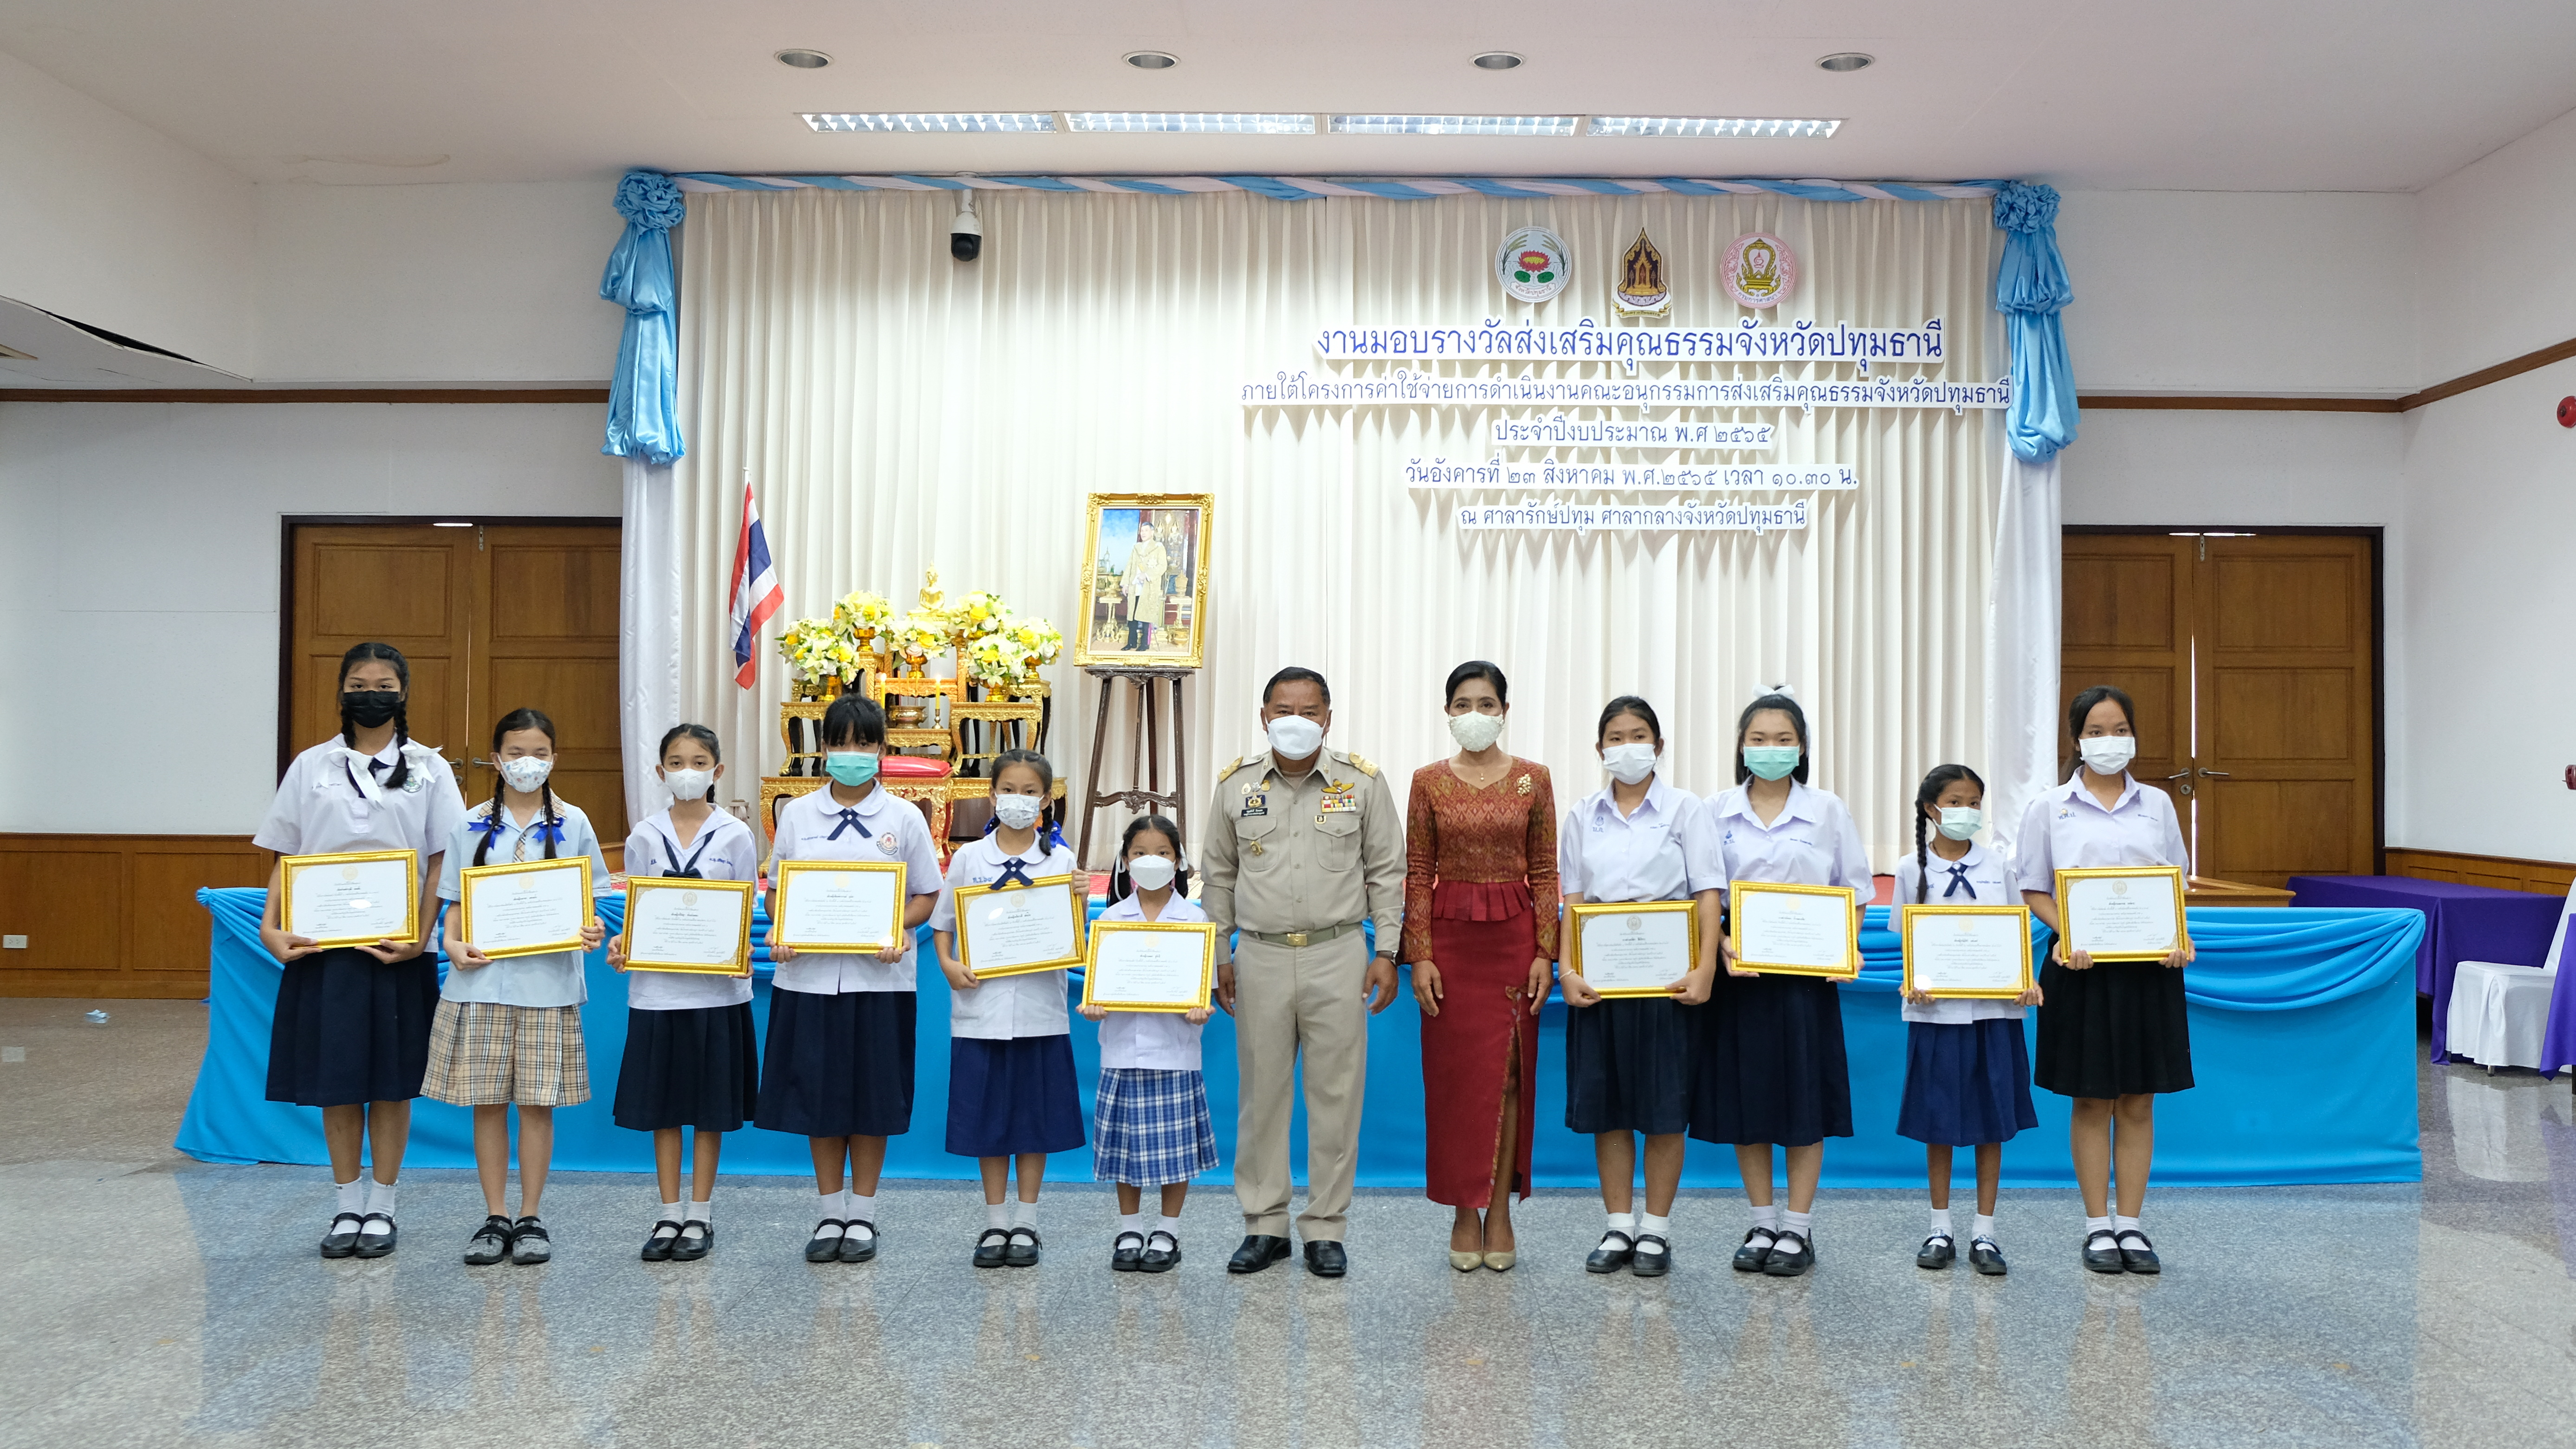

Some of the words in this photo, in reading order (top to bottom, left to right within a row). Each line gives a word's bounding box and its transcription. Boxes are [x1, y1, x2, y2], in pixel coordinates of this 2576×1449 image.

[1738, 291, 1778, 304] กรมการศาสนา
[1317, 318, 1943, 373] งานมอบรางวัลส่งเสริมคุณธรรมจังหวัดปทุมธานี
[1241, 370, 2011, 413] ภายใต้โครงการค่าใช้จ่ายการดำเนินงานคณะอนุกรรมการส่งเสริมคุณธรรมจังหวัดปทุมธานี
[1496, 416, 1667, 442] ประจำปีงบประมาณ
[1675, 425, 1708, 442] พ.ศ
[1714, 425, 1772, 443] ๒๕๖๕
[1406, 453, 1500, 484] วันอังคารที่
[1507, 466, 1536, 484] ๒๓
[1543, 459, 1615, 485] สิงหาคม
[1724, 469, 1764, 485] เวลา
[1772, 472, 1831, 487] ๑๐.๓๐
[1839, 468, 1858, 485] น.
[1461, 510, 1476, 524] ณ
[1484, 502, 1594, 531] ศาลารักษ์ปทุม
[1602, 499, 1806, 534] ศาลากลางจังหวัดปทุมธานี
